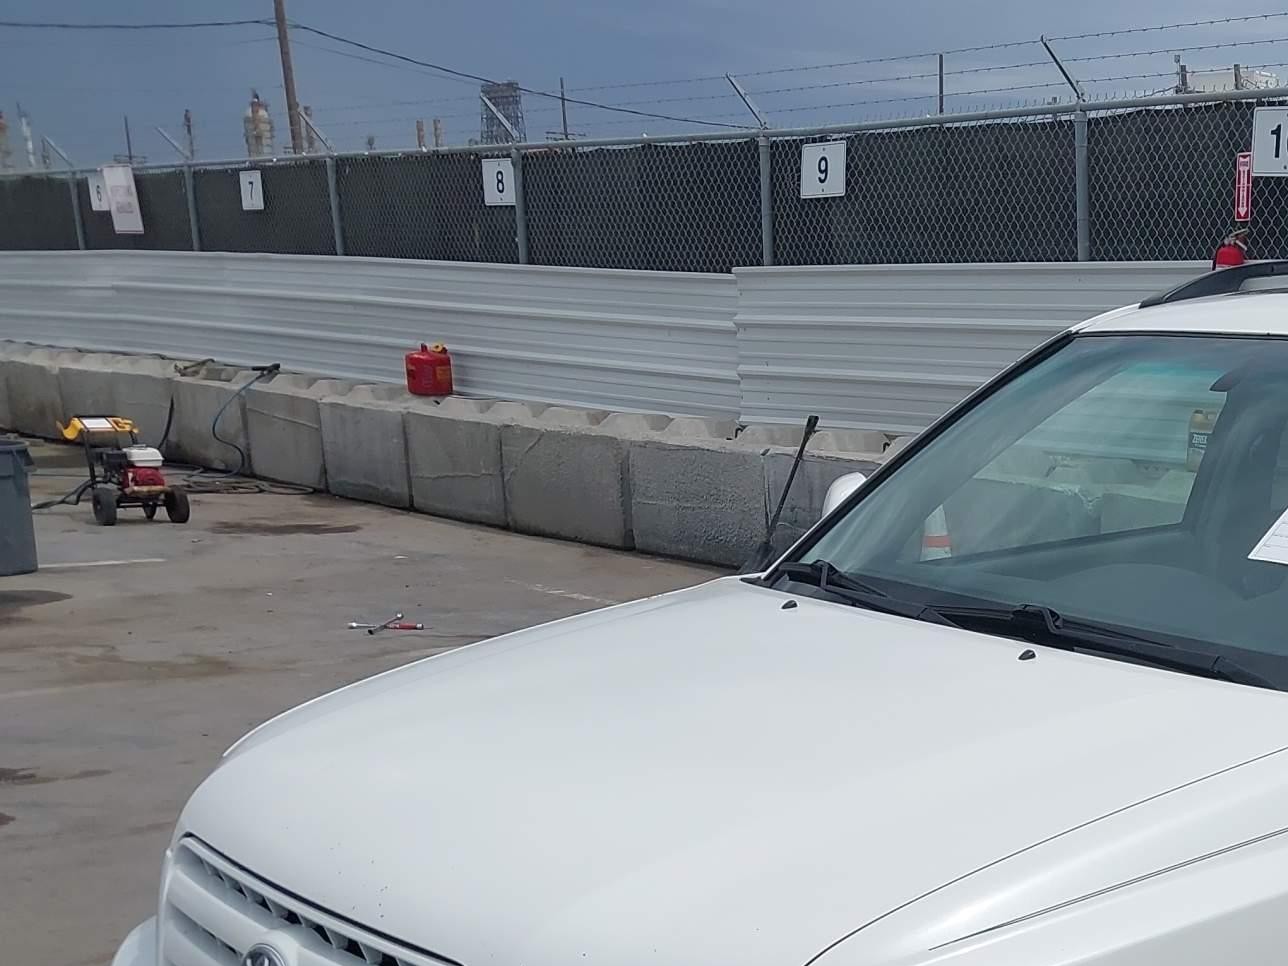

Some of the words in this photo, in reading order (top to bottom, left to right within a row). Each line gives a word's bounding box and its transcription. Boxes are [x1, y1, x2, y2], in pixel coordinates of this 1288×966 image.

[817, 156, 829, 184] 9
[95, 184, 102, 202] 6
[247, 180, 254, 200] 7
[495, 170, 505, 194] 8
